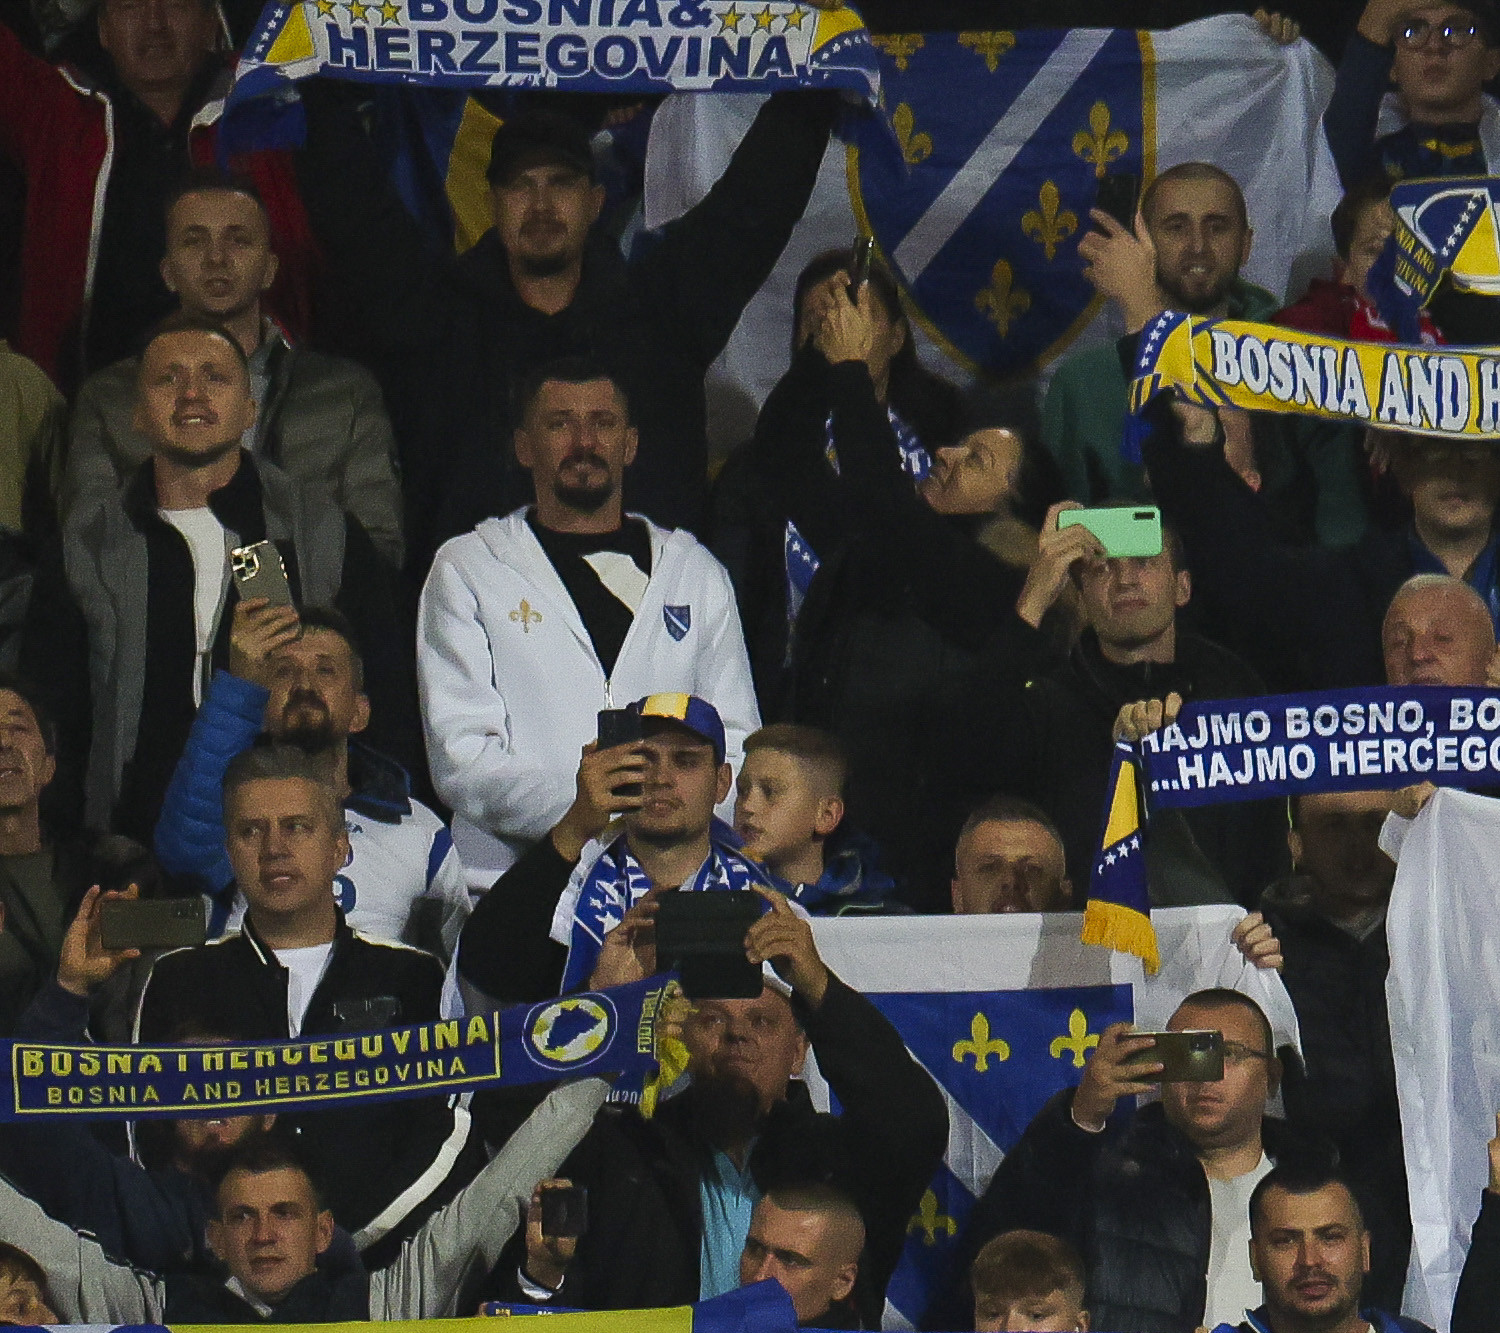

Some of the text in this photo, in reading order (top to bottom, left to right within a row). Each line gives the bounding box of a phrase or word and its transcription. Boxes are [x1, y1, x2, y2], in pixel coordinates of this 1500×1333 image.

[326, 20, 793, 77] HERZEGOVINA
[1211, 328, 1369, 420] BOSNIA
[1377, 355, 1470, 431] AND
[1285, 700, 1435, 742] BOSNO,
[48, 1057, 465, 1104] BOSNIA AND HERZEGOVINA
